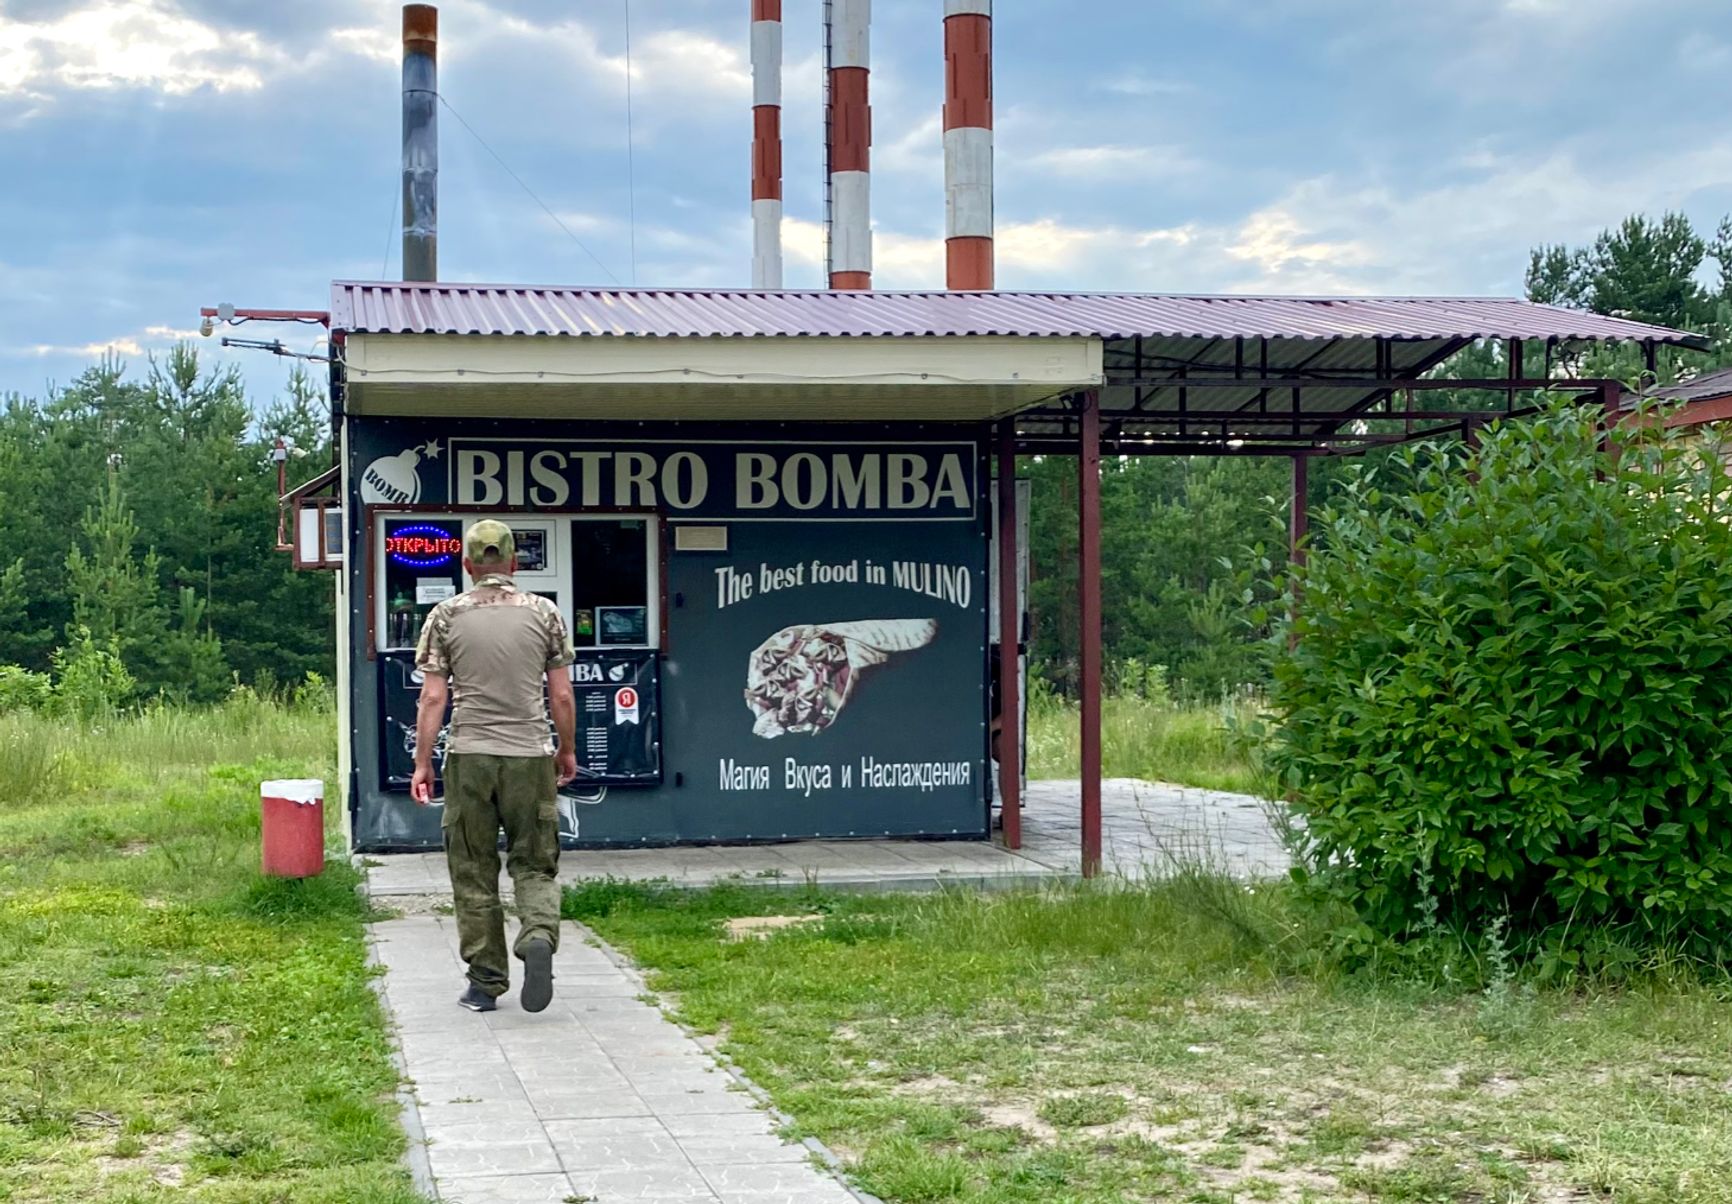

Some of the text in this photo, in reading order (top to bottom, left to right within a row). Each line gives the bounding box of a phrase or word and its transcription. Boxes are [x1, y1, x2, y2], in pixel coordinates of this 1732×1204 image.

[457, 450, 971, 509] BISTRO BOMBA
[385, 537, 462, 554] ОТКРЫТО
[715, 559, 971, 609] The best food in MULINO
[719, 755, 971, 797] Магия Вкуса и Наслаждения
